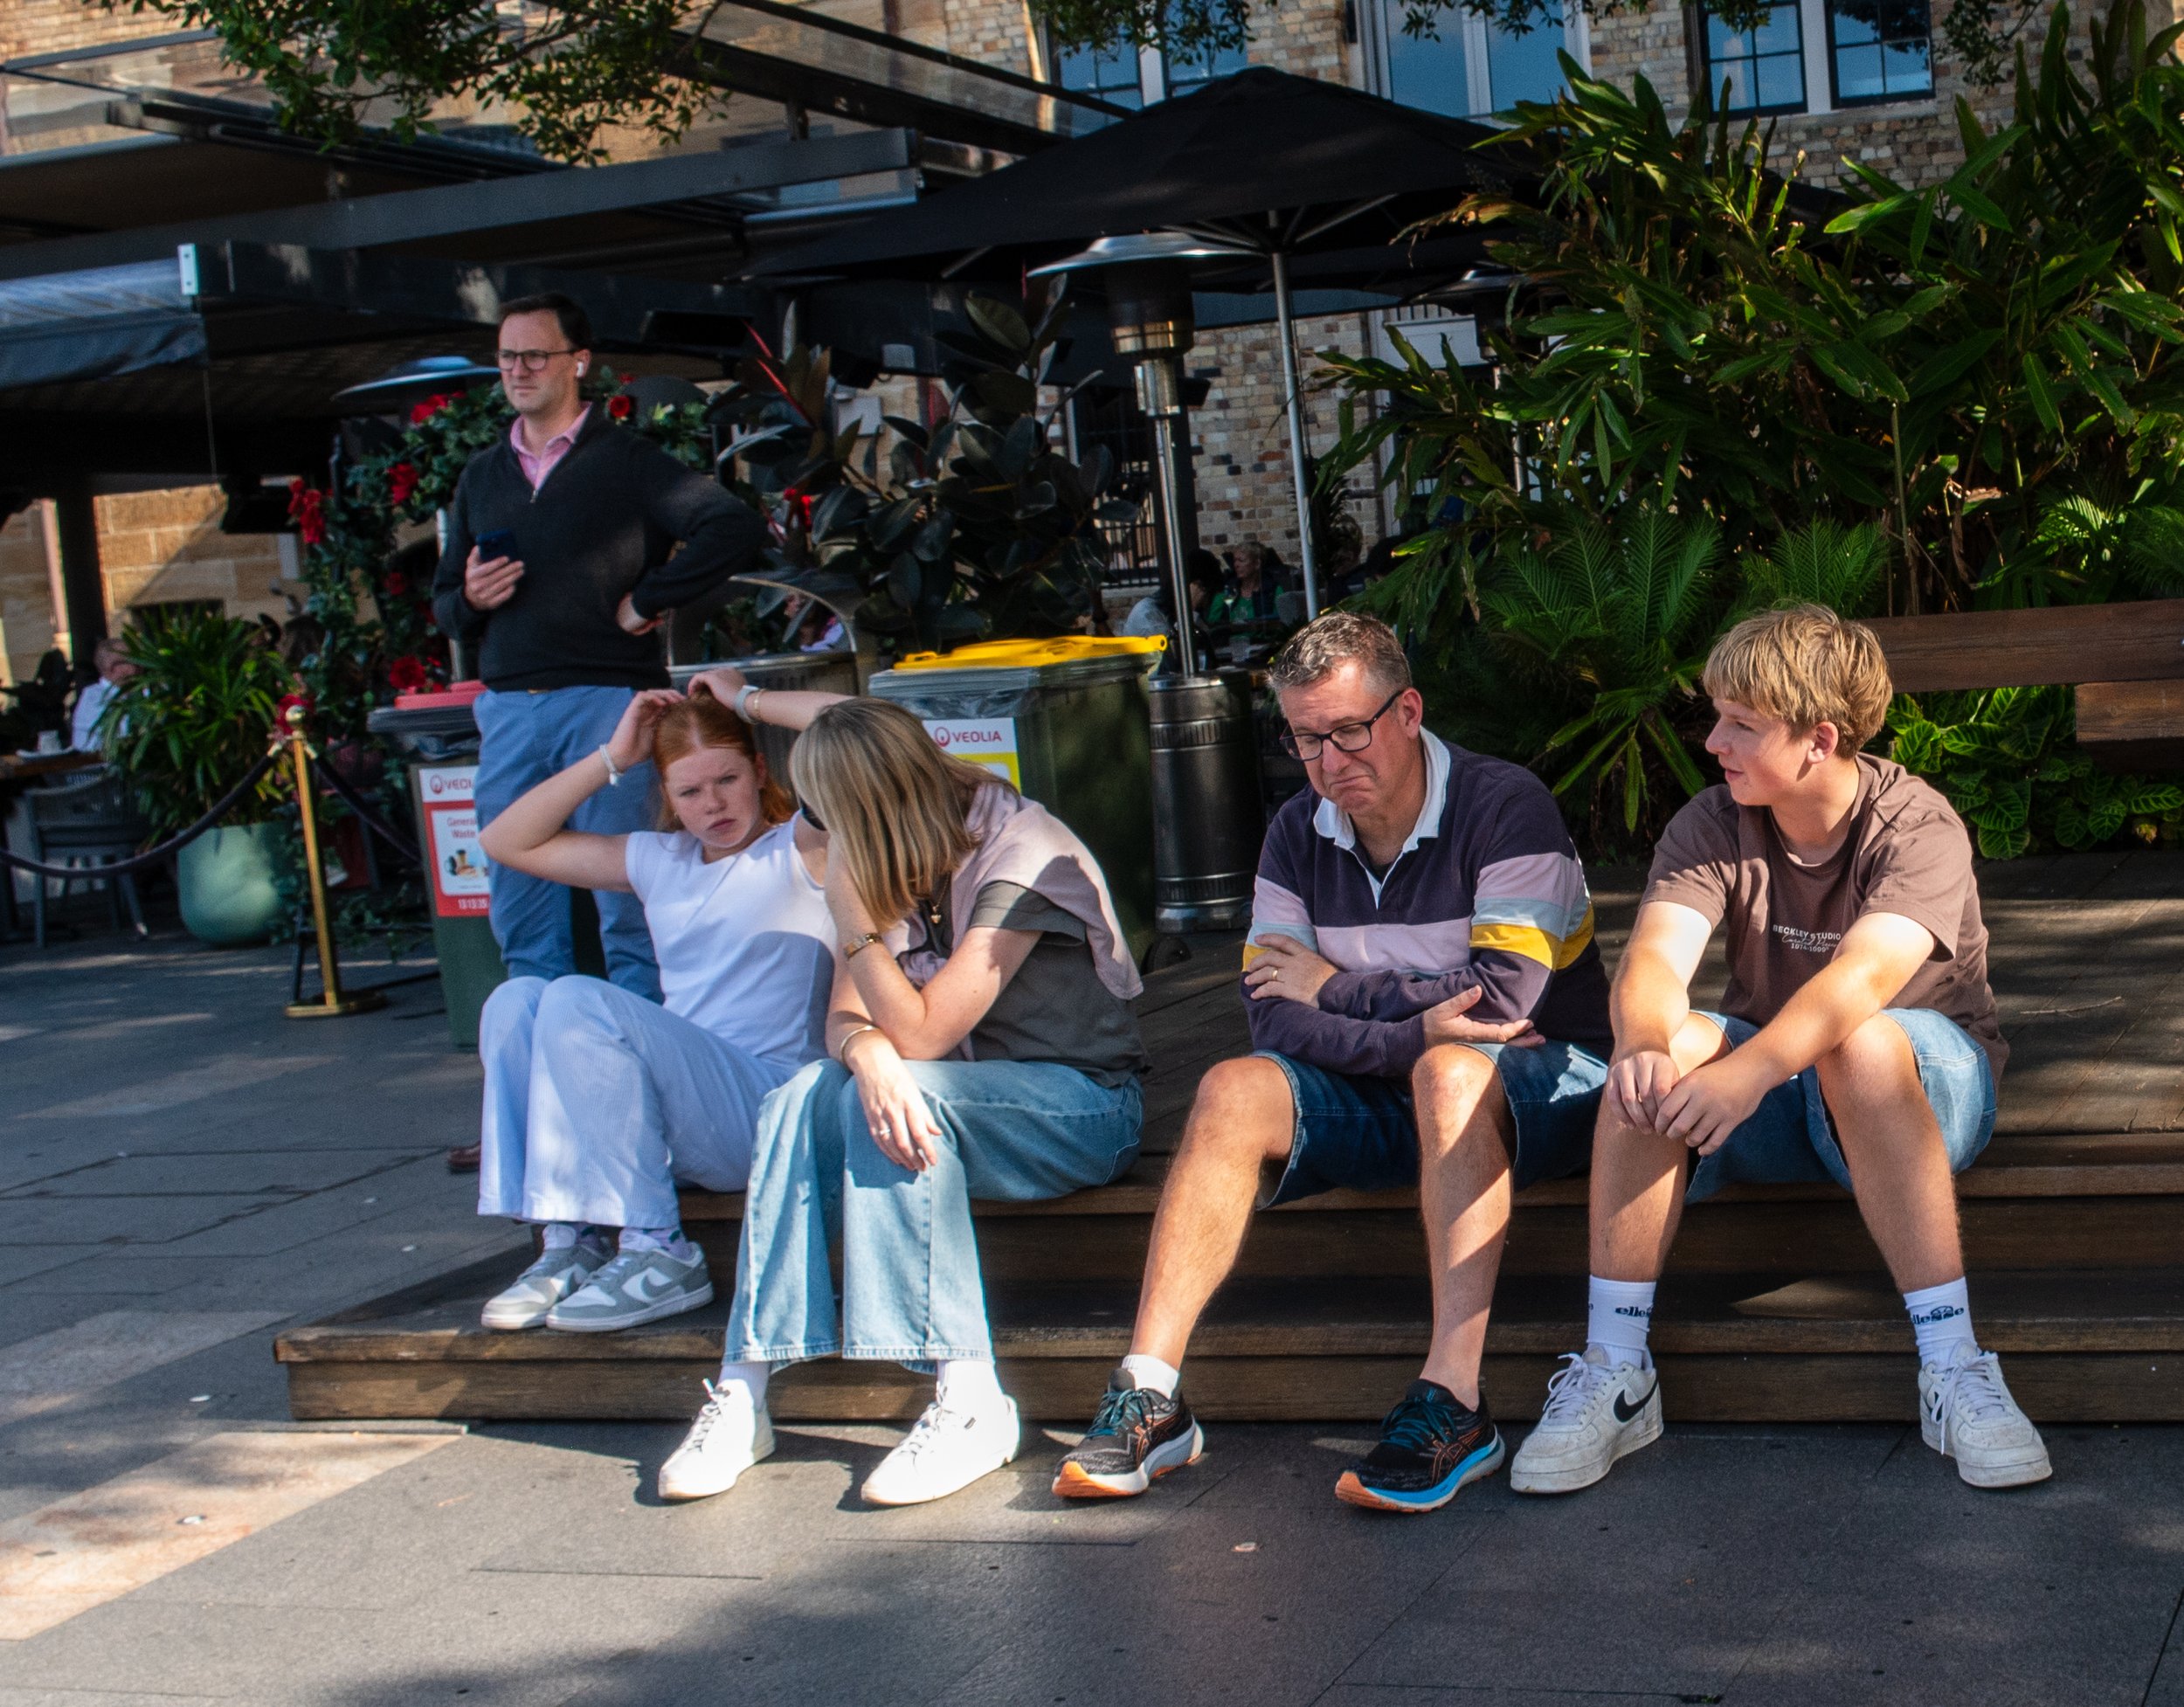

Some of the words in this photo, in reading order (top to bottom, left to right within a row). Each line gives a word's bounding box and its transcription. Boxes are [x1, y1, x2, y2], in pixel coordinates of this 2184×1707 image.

[951, 730, 1003, 743] VEOLIA
[446, 816, 476, 826] Genera
[1773, 924, 1809, 937] BECKLEY
[1810, 931, 1842, 941] STUDIO
[1913, 1305, 1965, 1325] llesse
